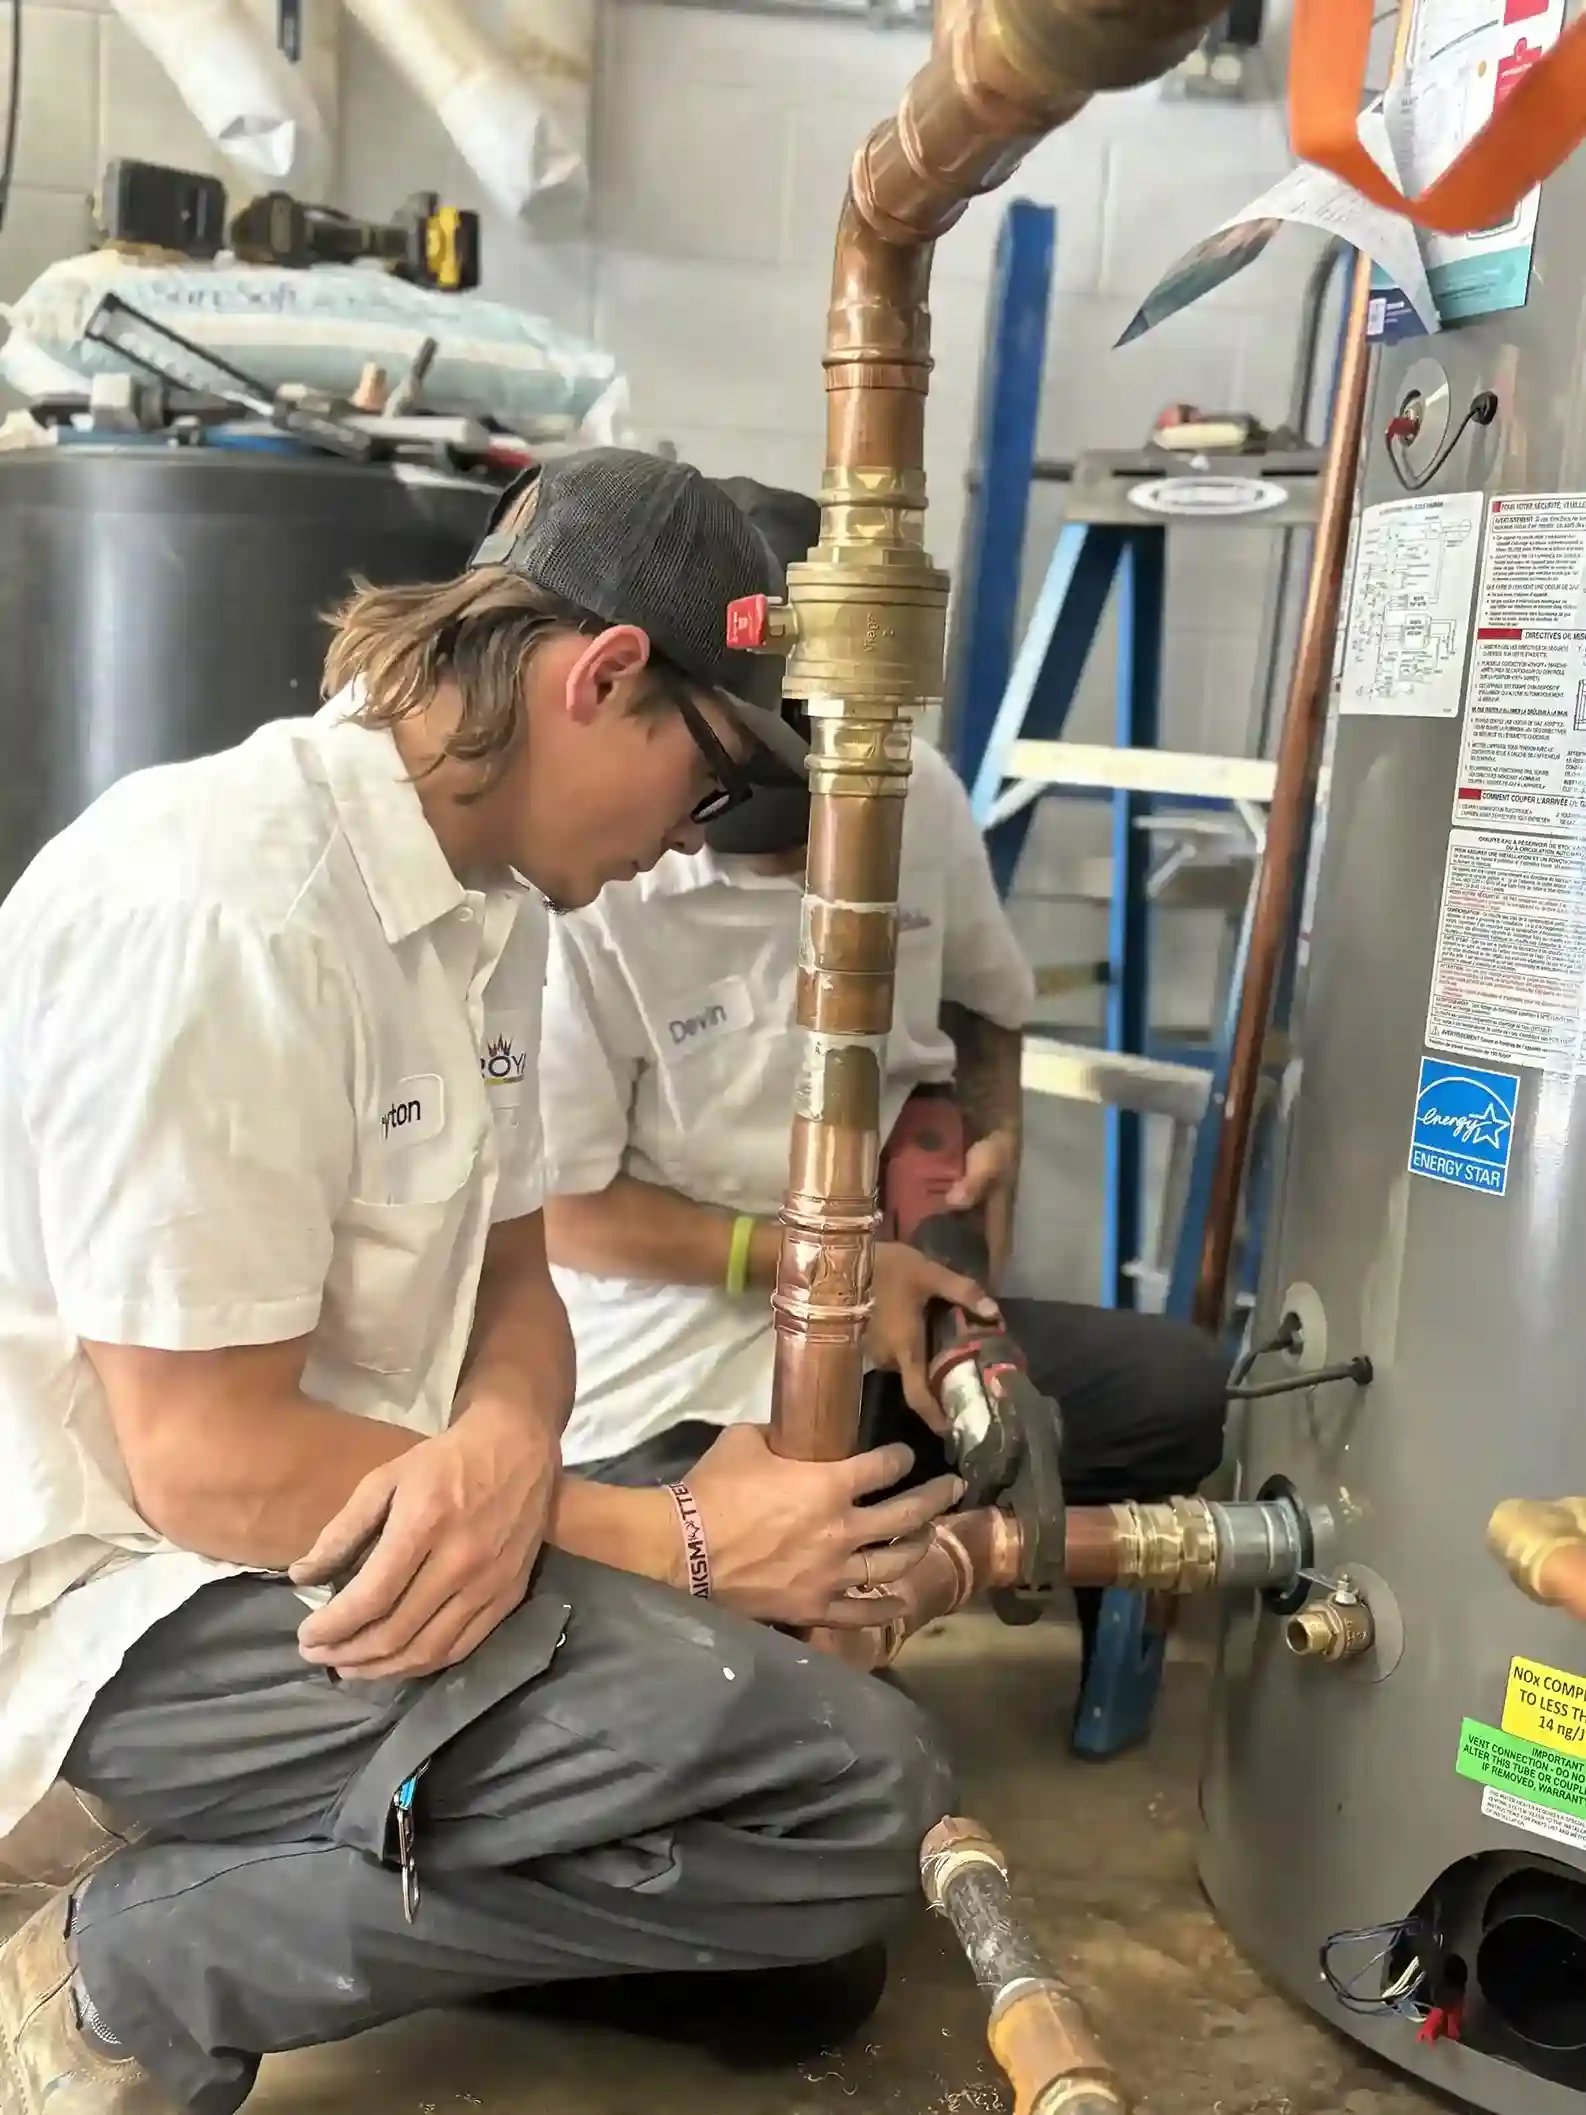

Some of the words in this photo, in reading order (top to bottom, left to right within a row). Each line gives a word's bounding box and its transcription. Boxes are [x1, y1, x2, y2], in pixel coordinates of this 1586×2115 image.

[1525, 631, 1561, 640] DIRECTIVES
[1562, 632, 1572, 640] DE
[1482, 792, 1510, 800] COMMENT
[1511, 794, 1536, 804] COUPER
[1536, 796, 1569, 807] L'ARRIVÉE
[669, 1005, 727, 1045] Devin
[1419, 1107, 1479, 1143] energy
[1413, 1150, 1464, 1177] ENERGY
[1464, 1164, 1501, 1188] STAR
[1513, 1665, 1540, 1687] NOx
[1543, 1676, 1586, 1702] COMP
[1519, 1687, 1537, 1706] TO
[1540, 1696, 1569, 1717] LESS
[1538, 1716, 1554, 1731] 14
[1557, 1724, 1585, 1741] ng/J
[1463, 1744, 1490, 1761] ALTER
[1491, 1754, 1511, 1769] THIS
[1512, 1762, 1536, 1779] TUBE
[1537, 1771, 1552, 1784] OR
[1553, 1777, 1586, 1796] COUPL
[1468, 1734, 1490, 1750] VENT
[1491, 1743, 1549, 1772] CONNECTION
[1555, 1766, 1569, 1778] DO
[1531, 1747, 1585, 1772] IMPORTANT
[1482, 1761, 1490, 1772] IF
[1491, 1765, 1537, 1791] REMOVED,
[1538, 1782, 1586, 1806] WARRANT
